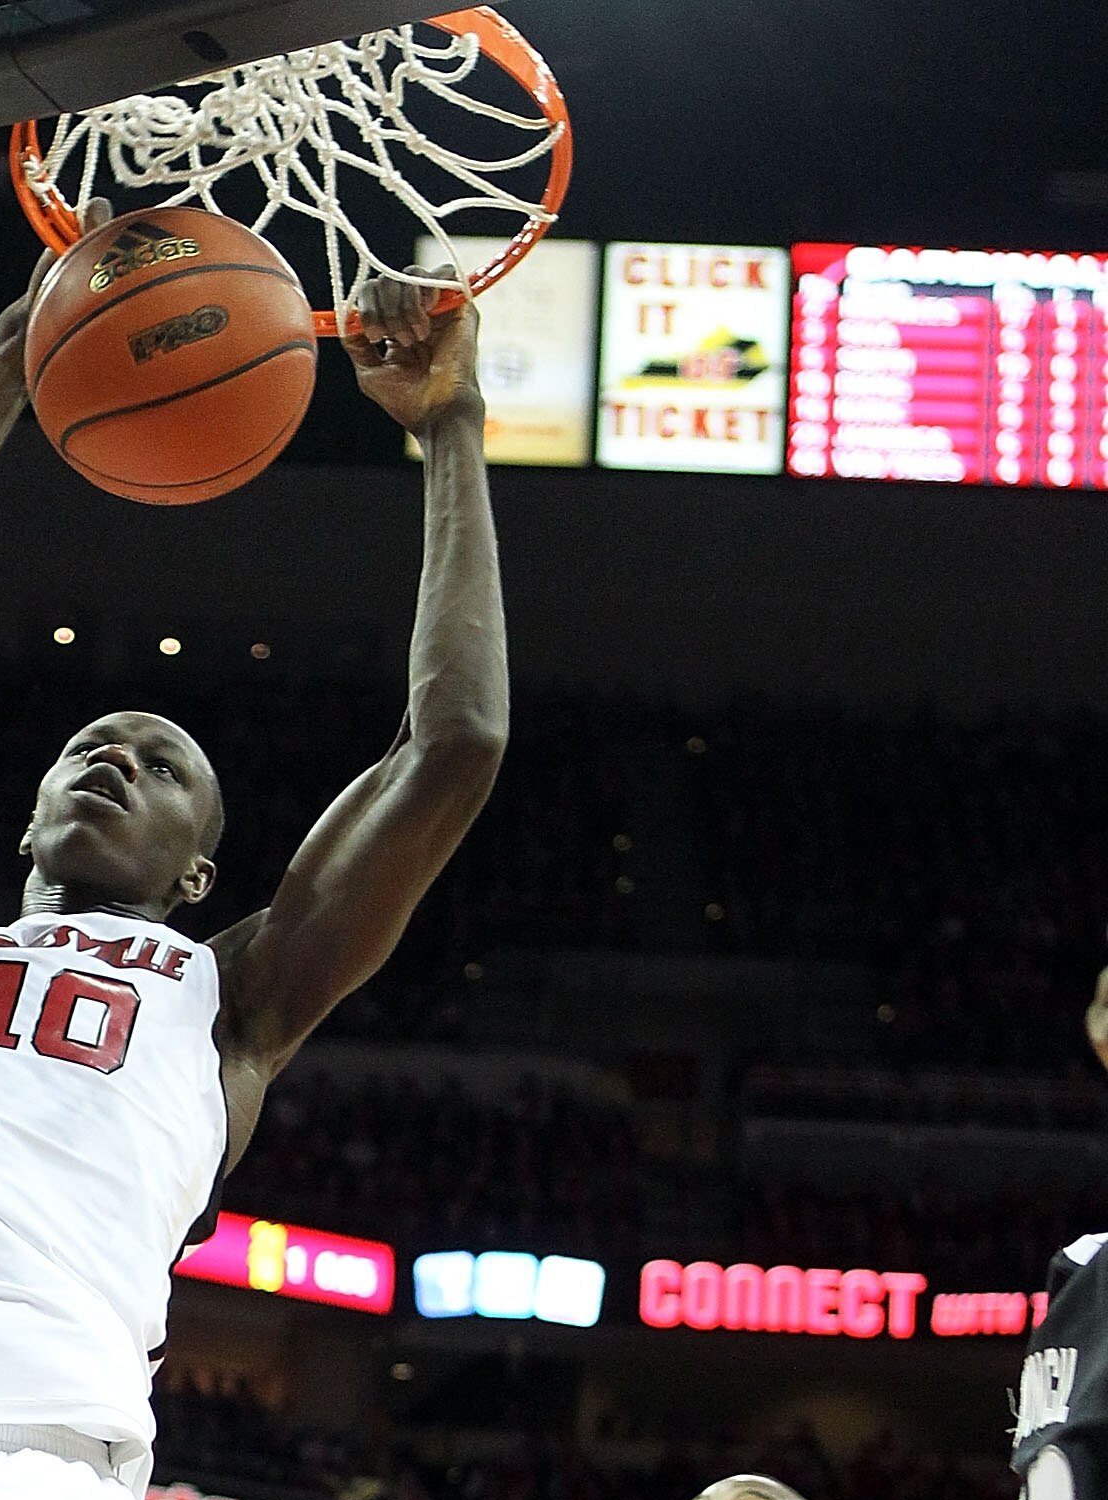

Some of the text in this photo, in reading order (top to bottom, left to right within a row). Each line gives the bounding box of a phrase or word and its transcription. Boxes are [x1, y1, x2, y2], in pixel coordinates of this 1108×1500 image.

[89, 238, 201, 293] adidas
[623, 256, 768, 289] CLICK
[637, 303, 675, 335] IT
[612, 403, 769, 442] TICKET
